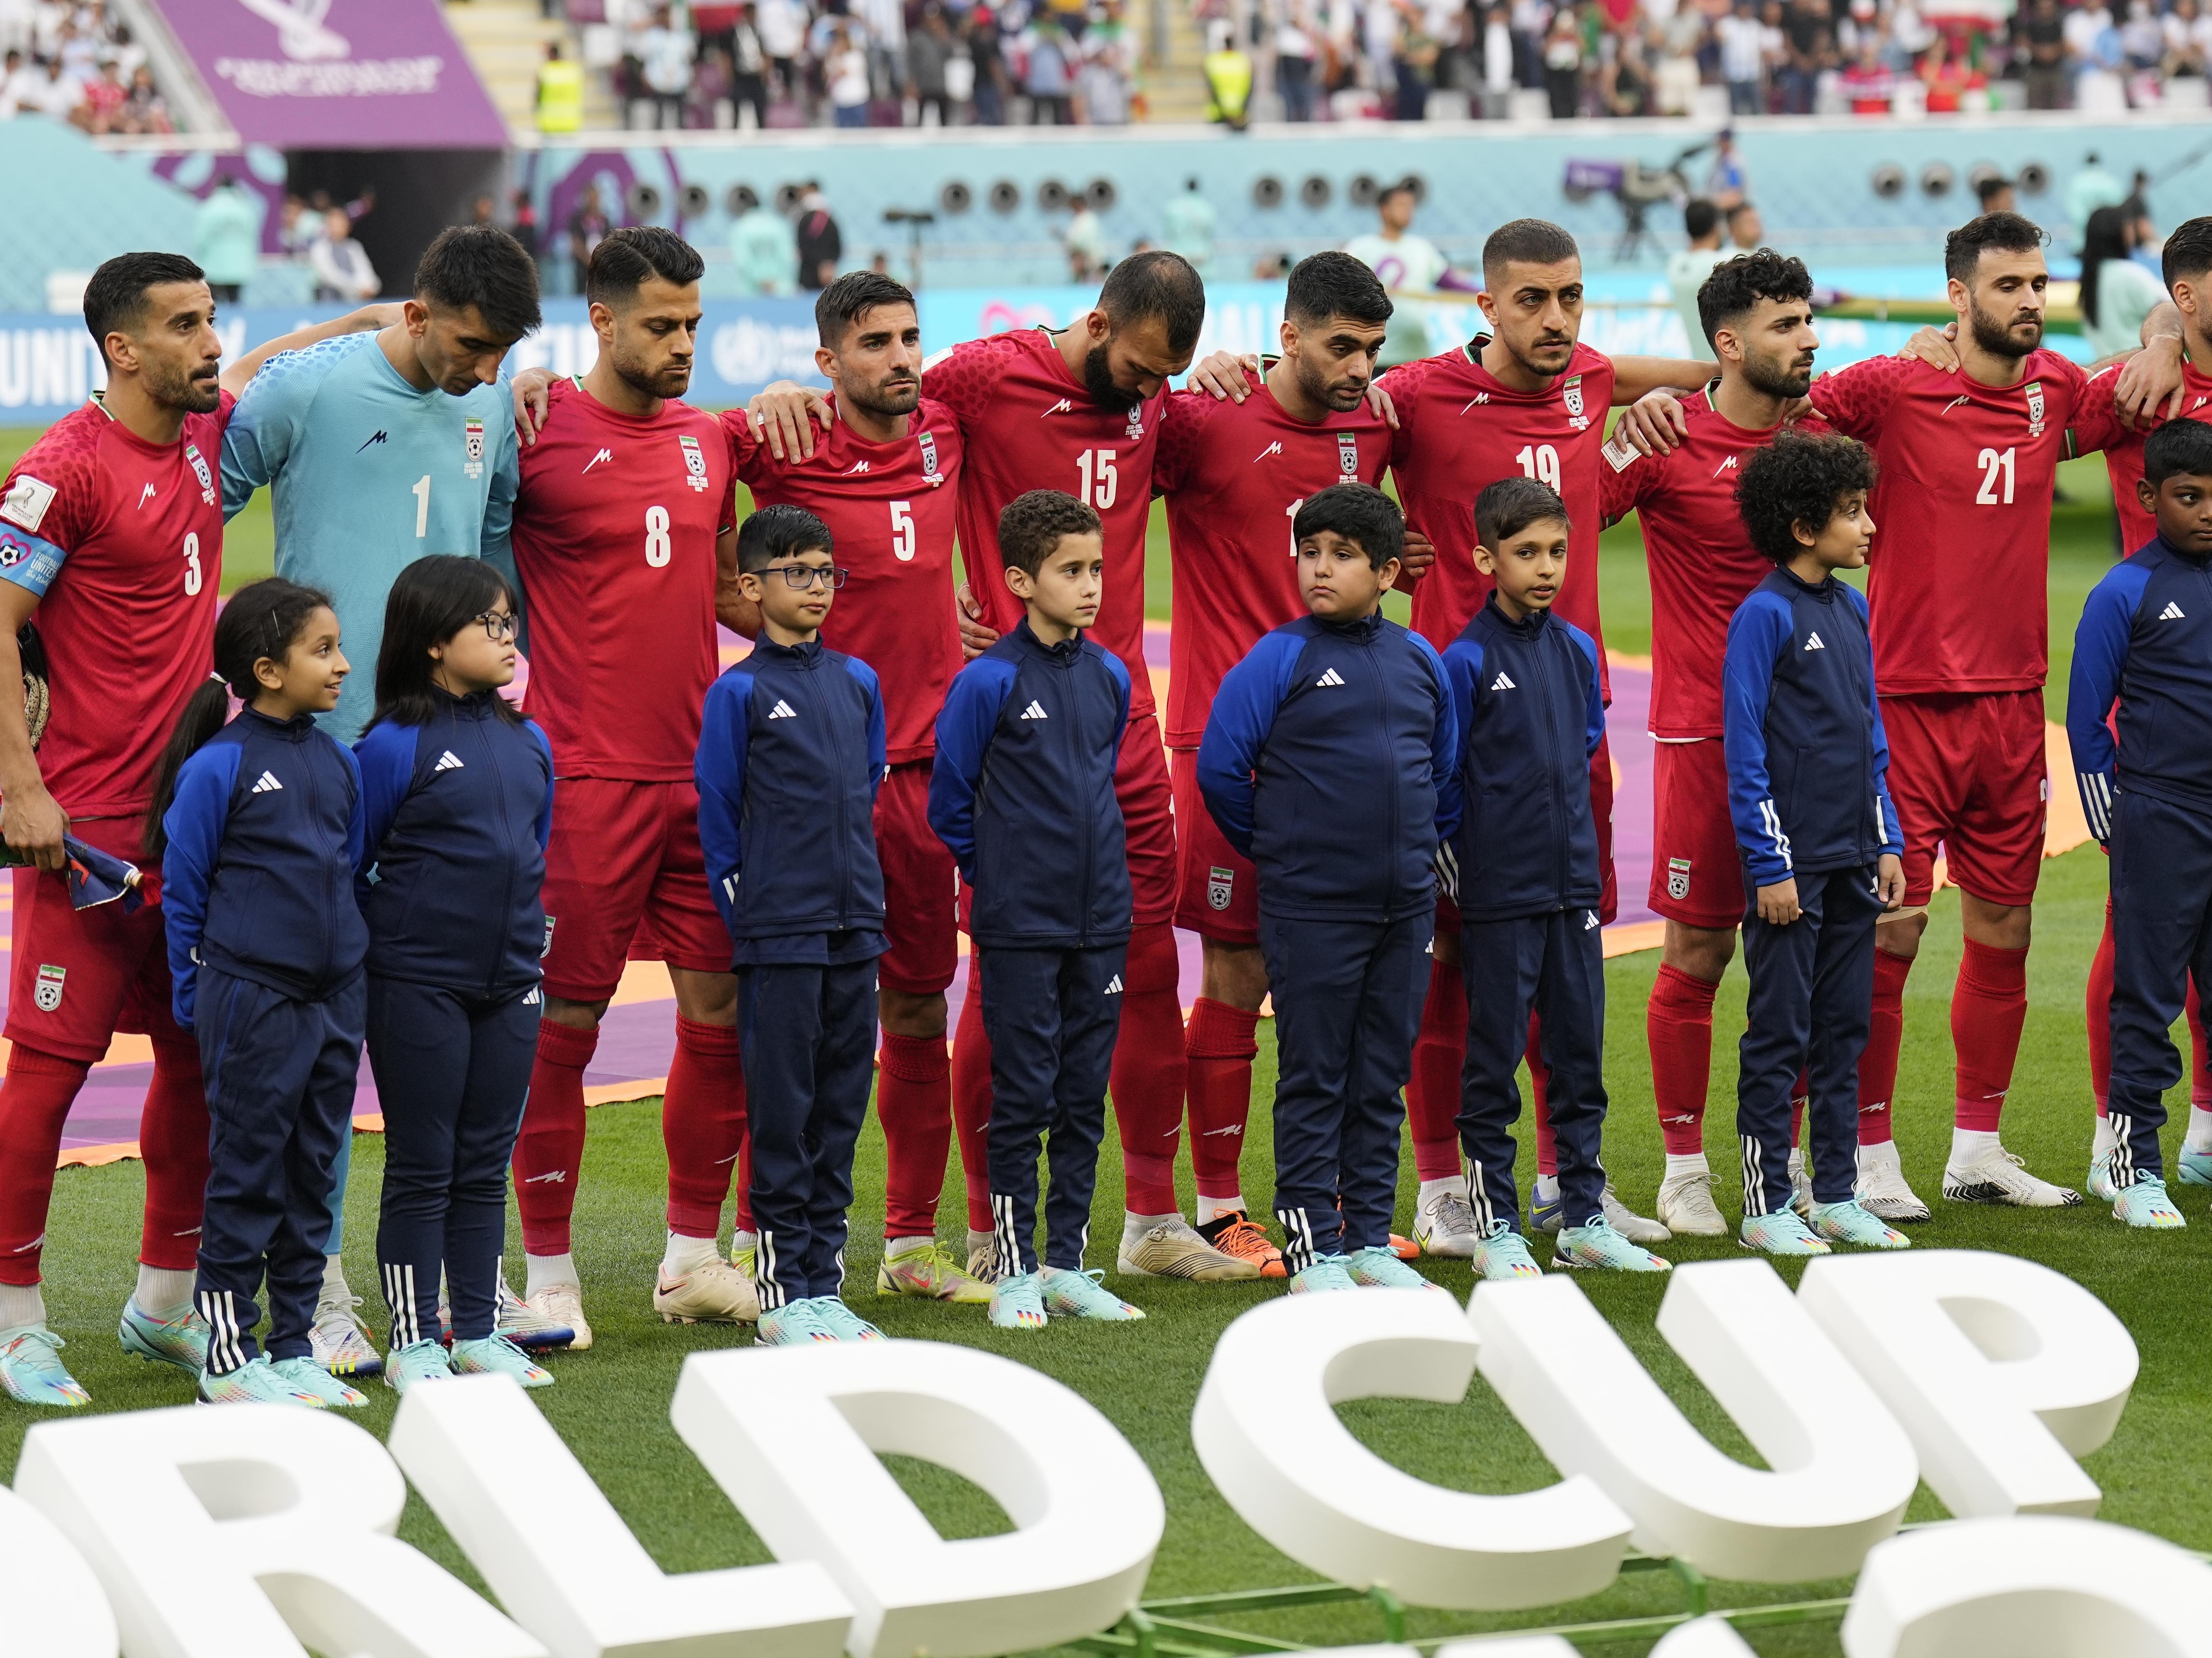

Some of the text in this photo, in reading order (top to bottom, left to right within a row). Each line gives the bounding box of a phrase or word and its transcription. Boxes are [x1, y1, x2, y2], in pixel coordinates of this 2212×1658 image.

[1077, 449, 1117, 509] 15
[1516, 445, 1561, 497] 19
[1976, 447, 2015, 505] 21
[412, 471, 434, 541] 1
[645, 505, 671, 567] 8
[890, 501, 915, 561] 5
[30, 559, 56, 579] UNITES
[35, 552, 60, 570] FOOTBALL
[184, 532, 202, 596] 3
[1192, 1249, 2140, 1612] CUP
